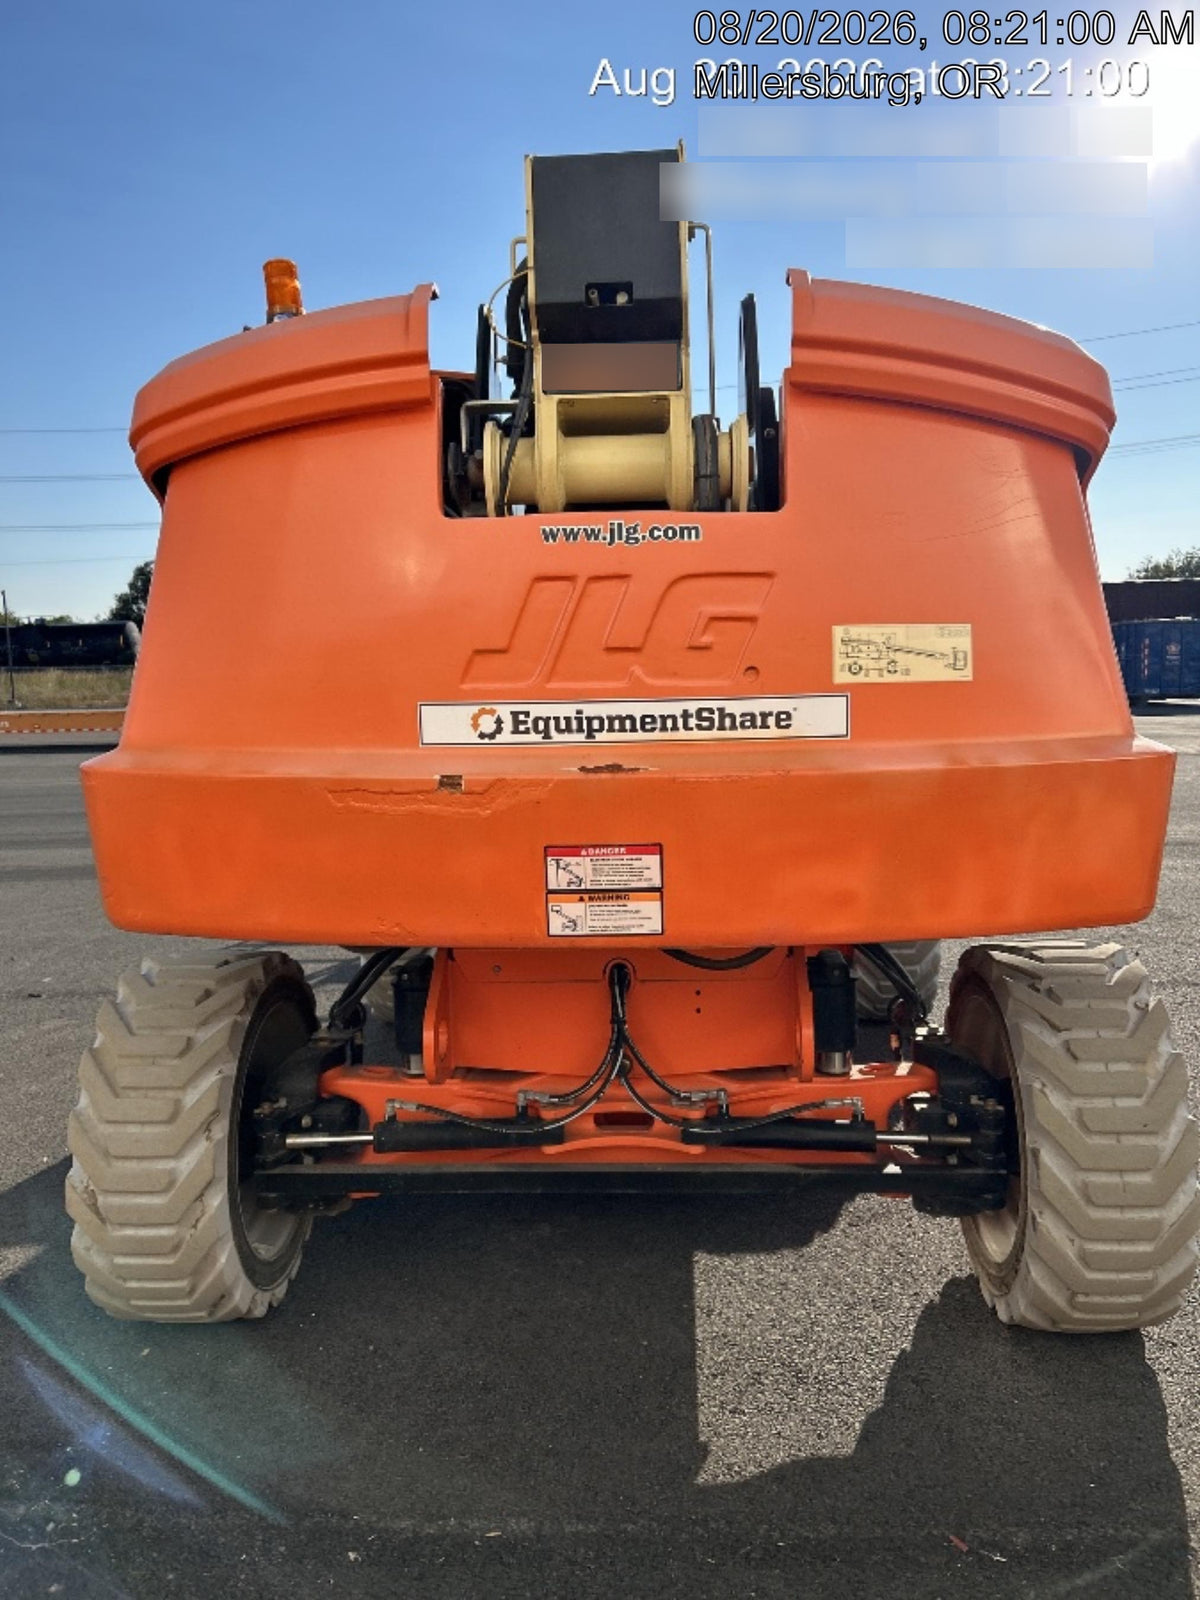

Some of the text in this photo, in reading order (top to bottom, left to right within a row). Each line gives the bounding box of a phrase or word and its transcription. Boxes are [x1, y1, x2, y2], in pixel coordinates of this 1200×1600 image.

[540, 521, 702, 546] www.jlg.com
[461, 571, 777, 690] JLG
[509, 706, 793, 740] EquipmentShare
